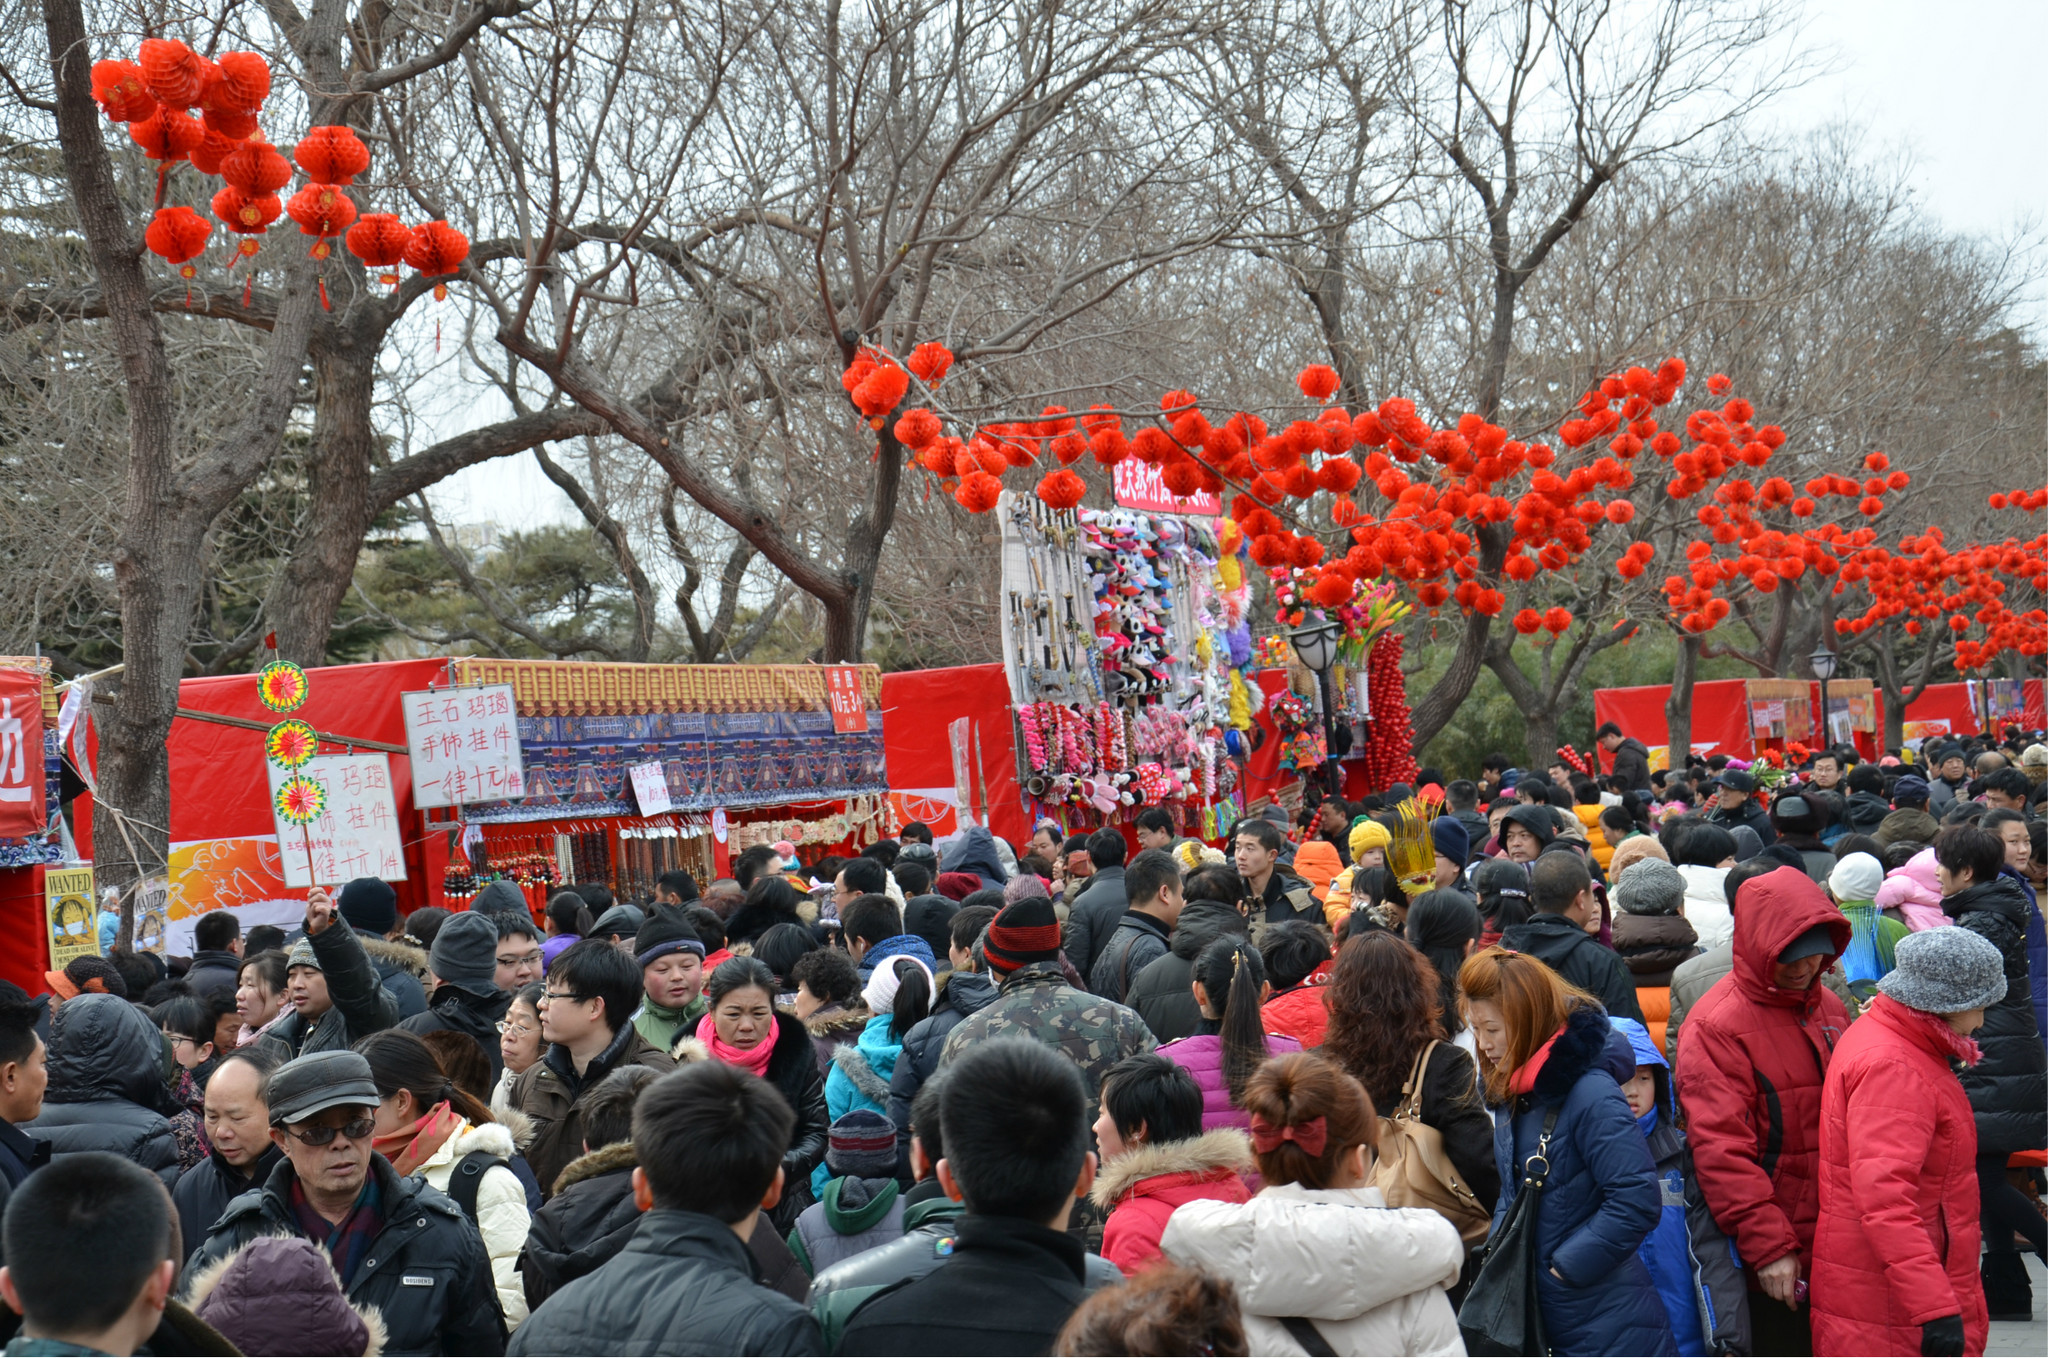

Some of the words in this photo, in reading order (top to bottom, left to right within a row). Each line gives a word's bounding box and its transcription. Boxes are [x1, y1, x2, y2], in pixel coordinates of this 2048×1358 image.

[417, 691, 509, 726] 玉石玛瑙
[421, 722, 512, 763] 手饰挂件
[285, 764, 386, 796] 石玛瑙
[420, 765, 522, 806] 一律十元/件
[288, 800, 392, 840] 饰挂件
[48, 873, 91, 894] WANTED
